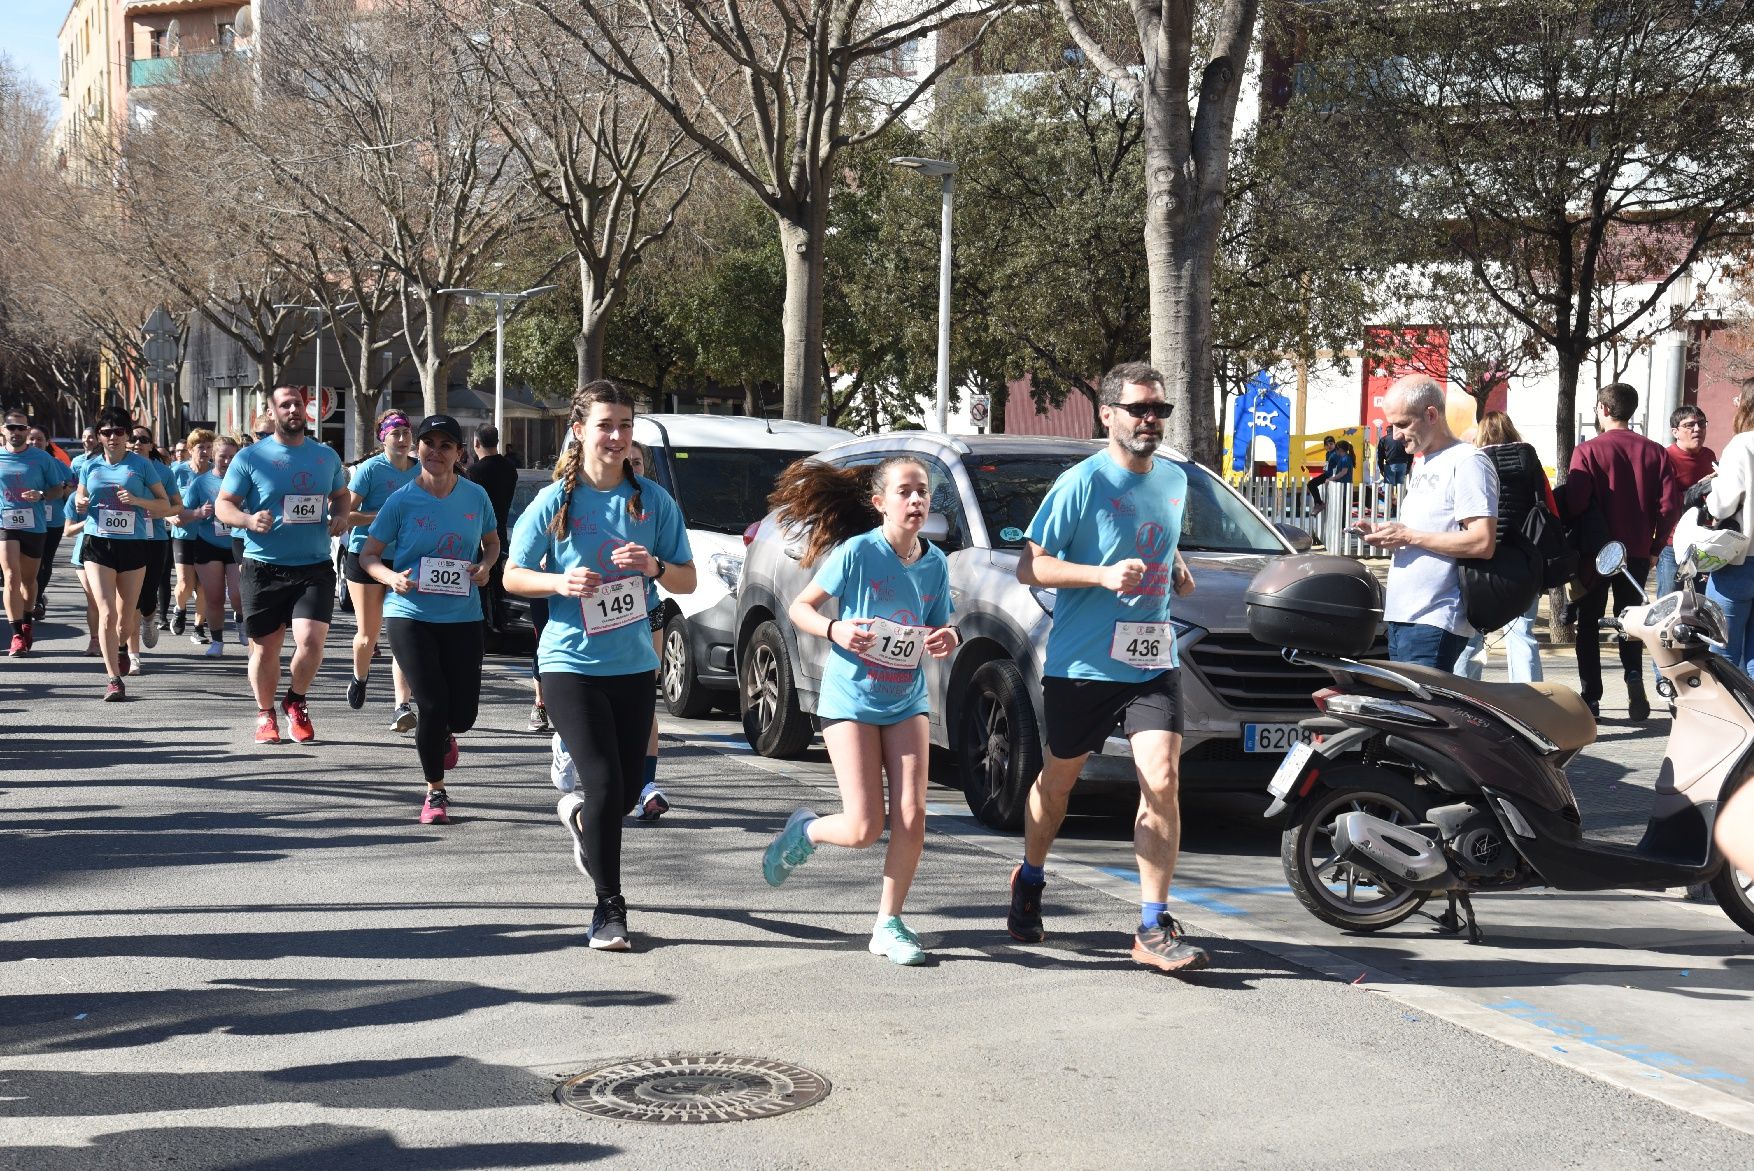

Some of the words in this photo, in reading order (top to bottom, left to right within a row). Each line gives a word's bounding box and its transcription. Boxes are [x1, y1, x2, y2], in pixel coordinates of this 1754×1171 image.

[292, 504, 315, 516] 464
[12, 515, 25, 524] 98
[105, 517, 128, 528] 800
[430, 569, 461, 585] 302
[597, 593, 635, 617] 149
[881, 635, 915, 658] 150
[1126, 638, 1161, 657] 436
[1259, 727, 1312, 749] 6208
